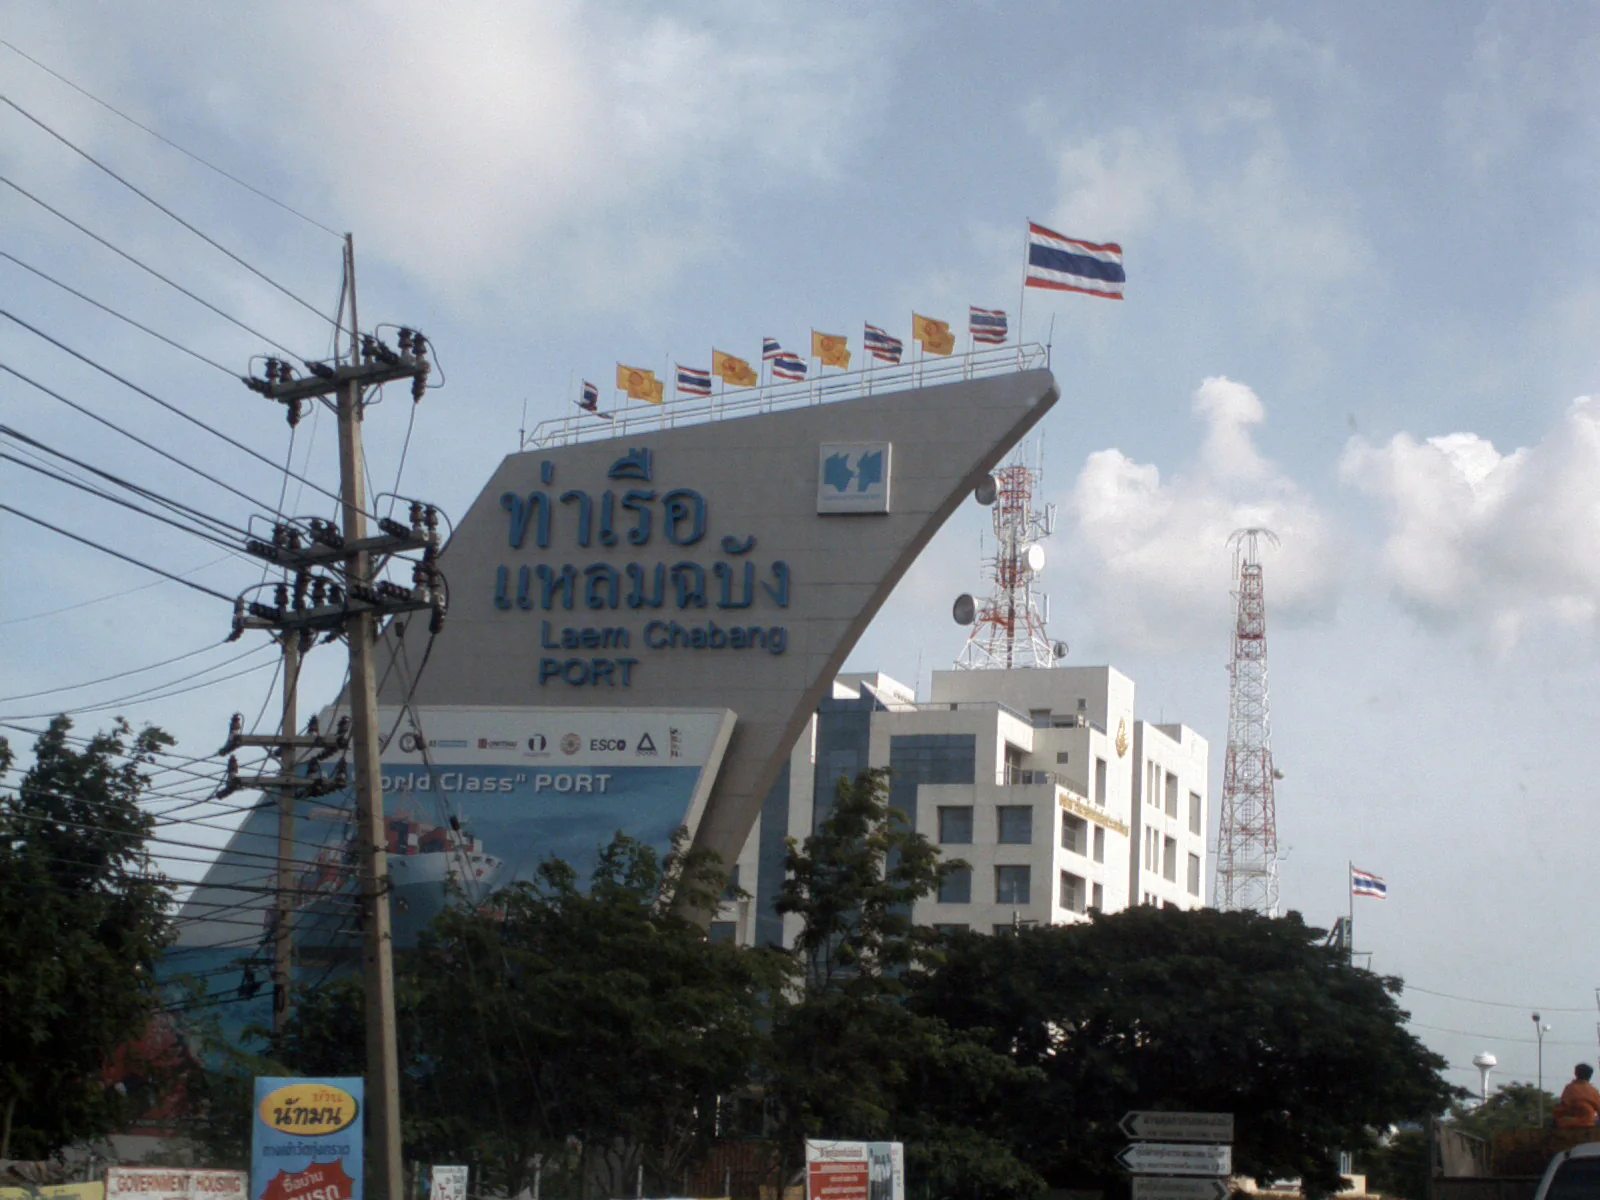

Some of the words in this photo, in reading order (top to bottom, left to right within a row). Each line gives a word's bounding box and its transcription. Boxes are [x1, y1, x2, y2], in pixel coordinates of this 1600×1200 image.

[501, 448, 707, 548] ท่าเรือ
[494, 535, 791, 610] แหลมฉบัง
[541, 620, 630, 650] Laem
[643, 620, 788, 655] Chabang
[539, 657, 638, 686] PORT
[589, 738, 627, 752] ESCO
[379, 772, 432, 793] orld
[440, 772, 528, 793] Class"
[534, 773, 612, 794] PORT
[117, 1174, 191, 1192] GOVERNMENT
[196, 1175, 242, 1193] HOUSING
